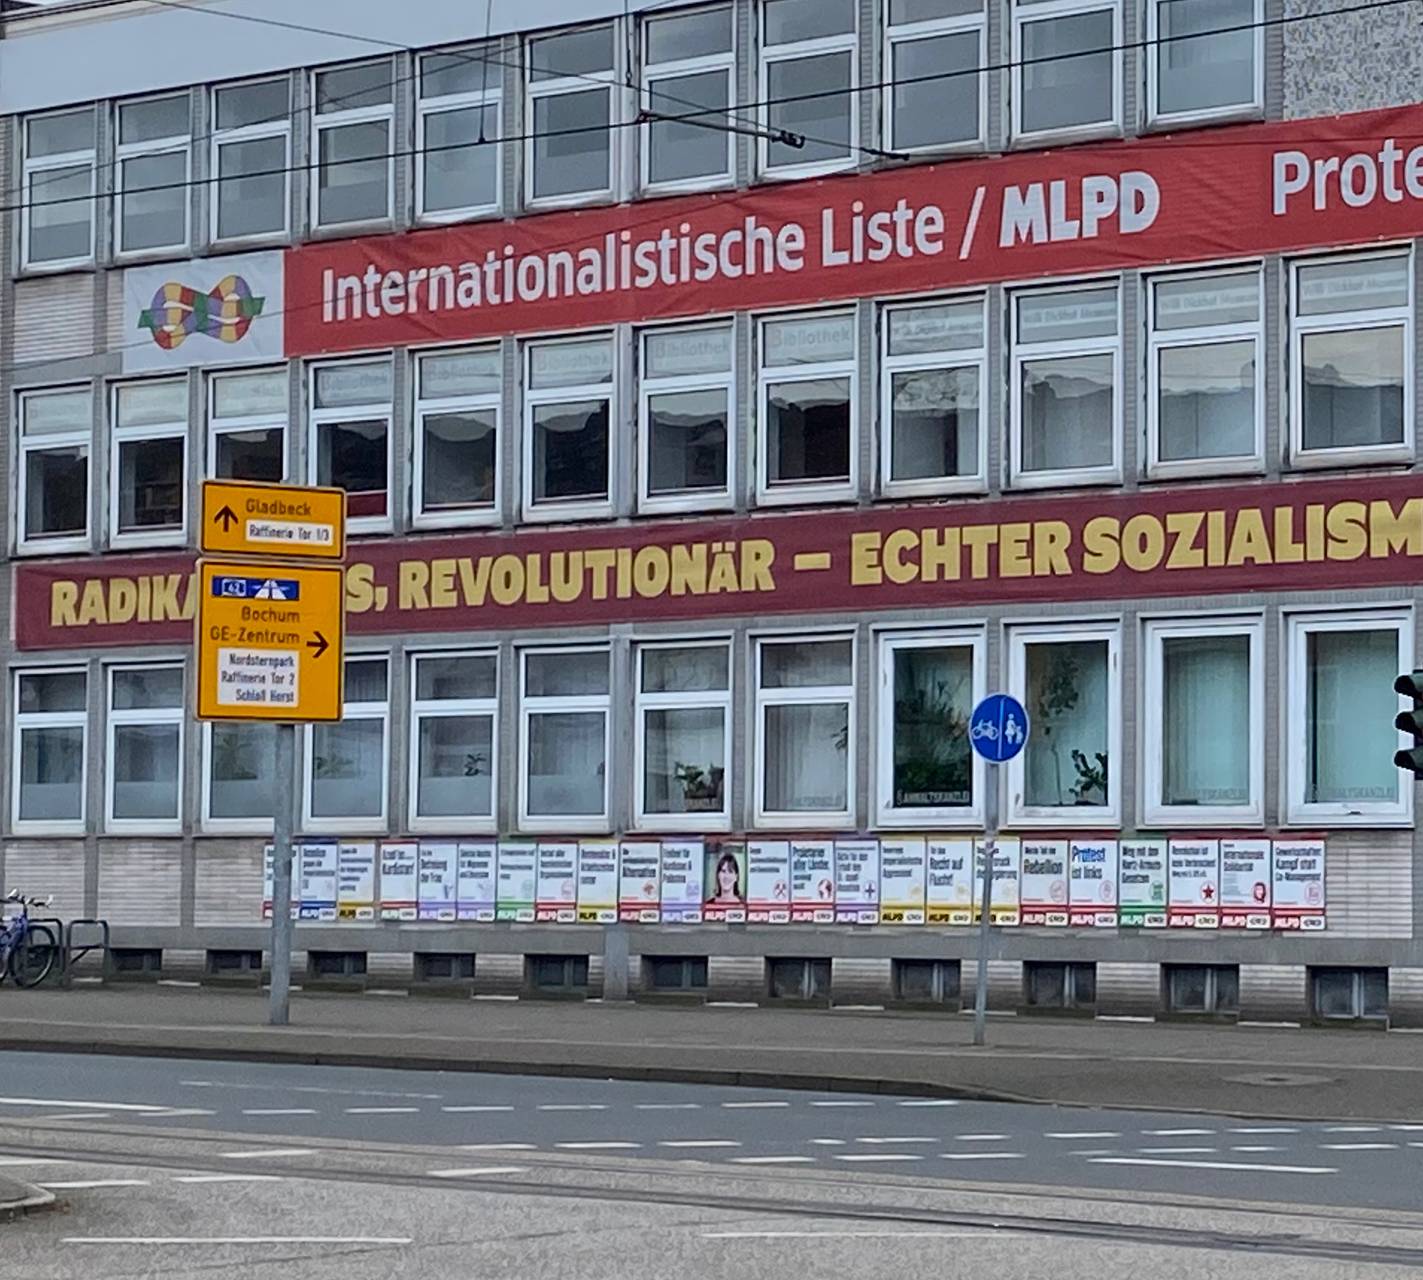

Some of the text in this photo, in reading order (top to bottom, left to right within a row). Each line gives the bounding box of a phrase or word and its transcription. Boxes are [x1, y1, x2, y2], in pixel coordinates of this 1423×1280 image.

[322, 171, 1160, 323] Internationalistische Liste / MLPD
[246, 498, 312, 516] Gladbeck
[399, 537, 776, 611] REVOLUTIONÄR
[850, 520, 1072, 586] ECHTER
[241, 605, 300, 623] Bochum
[210, 625, 300, 644] GE-Zentrum
[229, 653, 294, 669] Nordsternpark
